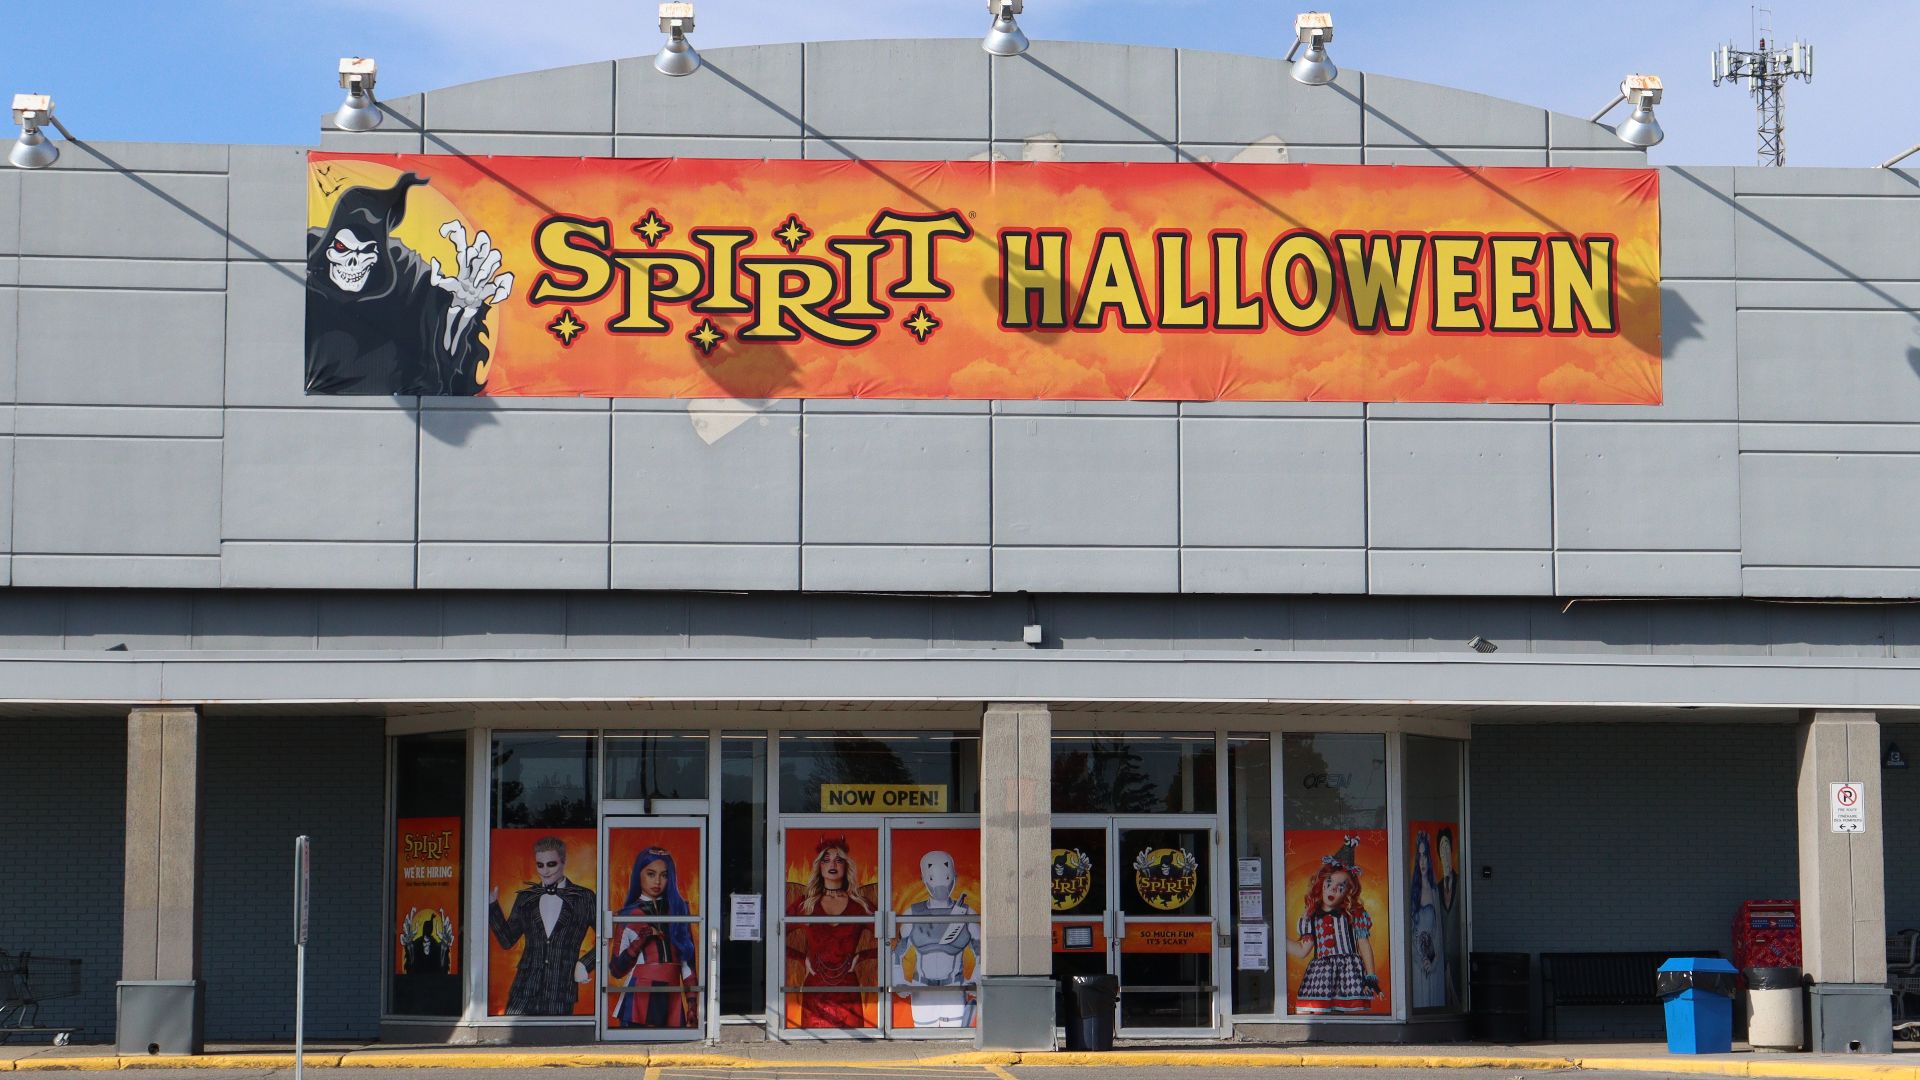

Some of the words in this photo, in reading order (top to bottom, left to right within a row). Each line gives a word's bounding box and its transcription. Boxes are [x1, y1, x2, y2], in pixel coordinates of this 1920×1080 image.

[529, 207, 971, 346] SPIRIT
[998, 226, 1620, 337] HALLOWEEN
[1303, 773, 1352, 789] OPEN
[829, 790, 875, 806] NOW
[882, 790, 939, 806] OPEN!
[404, 831, 453, 859] SPIRIT
[404, 865, 425, 879] WE'RE
[427, 866, 453, 879] HIRING
[1051, 876, 1087, 894] IRIT
[1141, 876, 1192, 893] SPIRIT
